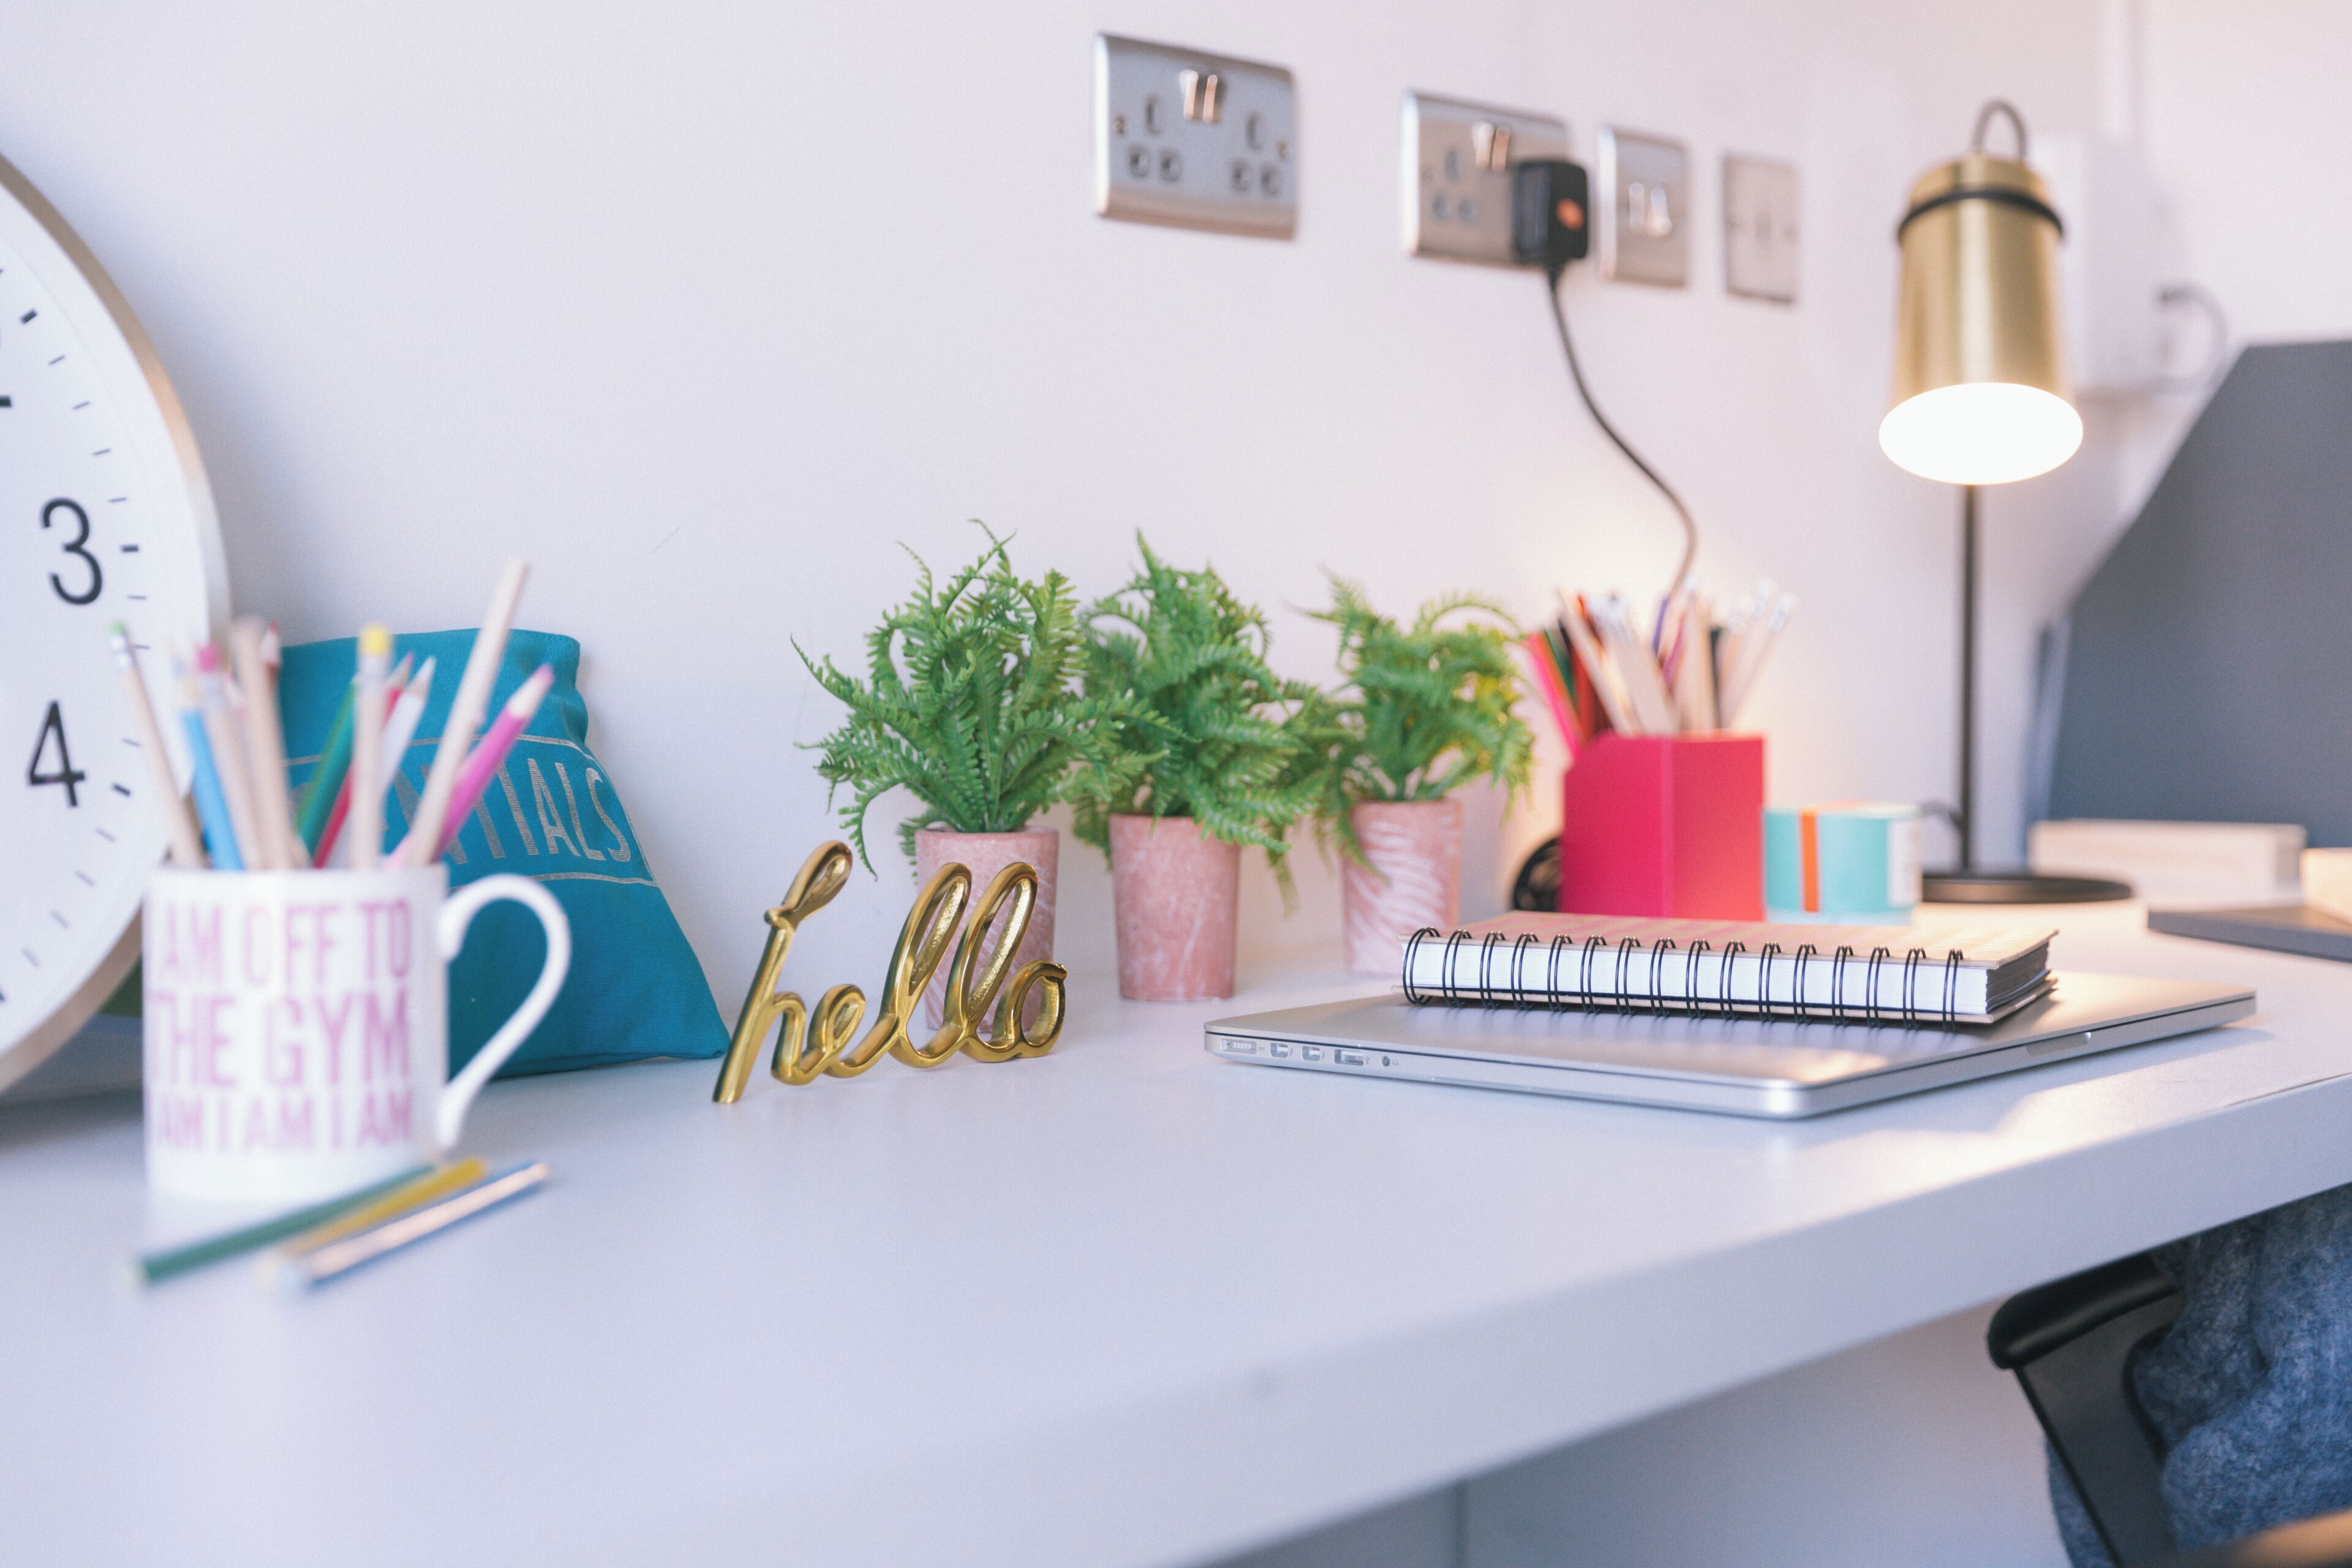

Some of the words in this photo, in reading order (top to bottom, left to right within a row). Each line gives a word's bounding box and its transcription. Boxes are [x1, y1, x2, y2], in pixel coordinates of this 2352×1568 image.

[42, 497, 103, 605] 3
[27, 699, 86, 807] 4
[355, 895, 413, 982] TO
[712, 840, 1067, 1103] hello
[147, 989, 236, 1088] THE
[263, 984, 410, 1088] GYM
